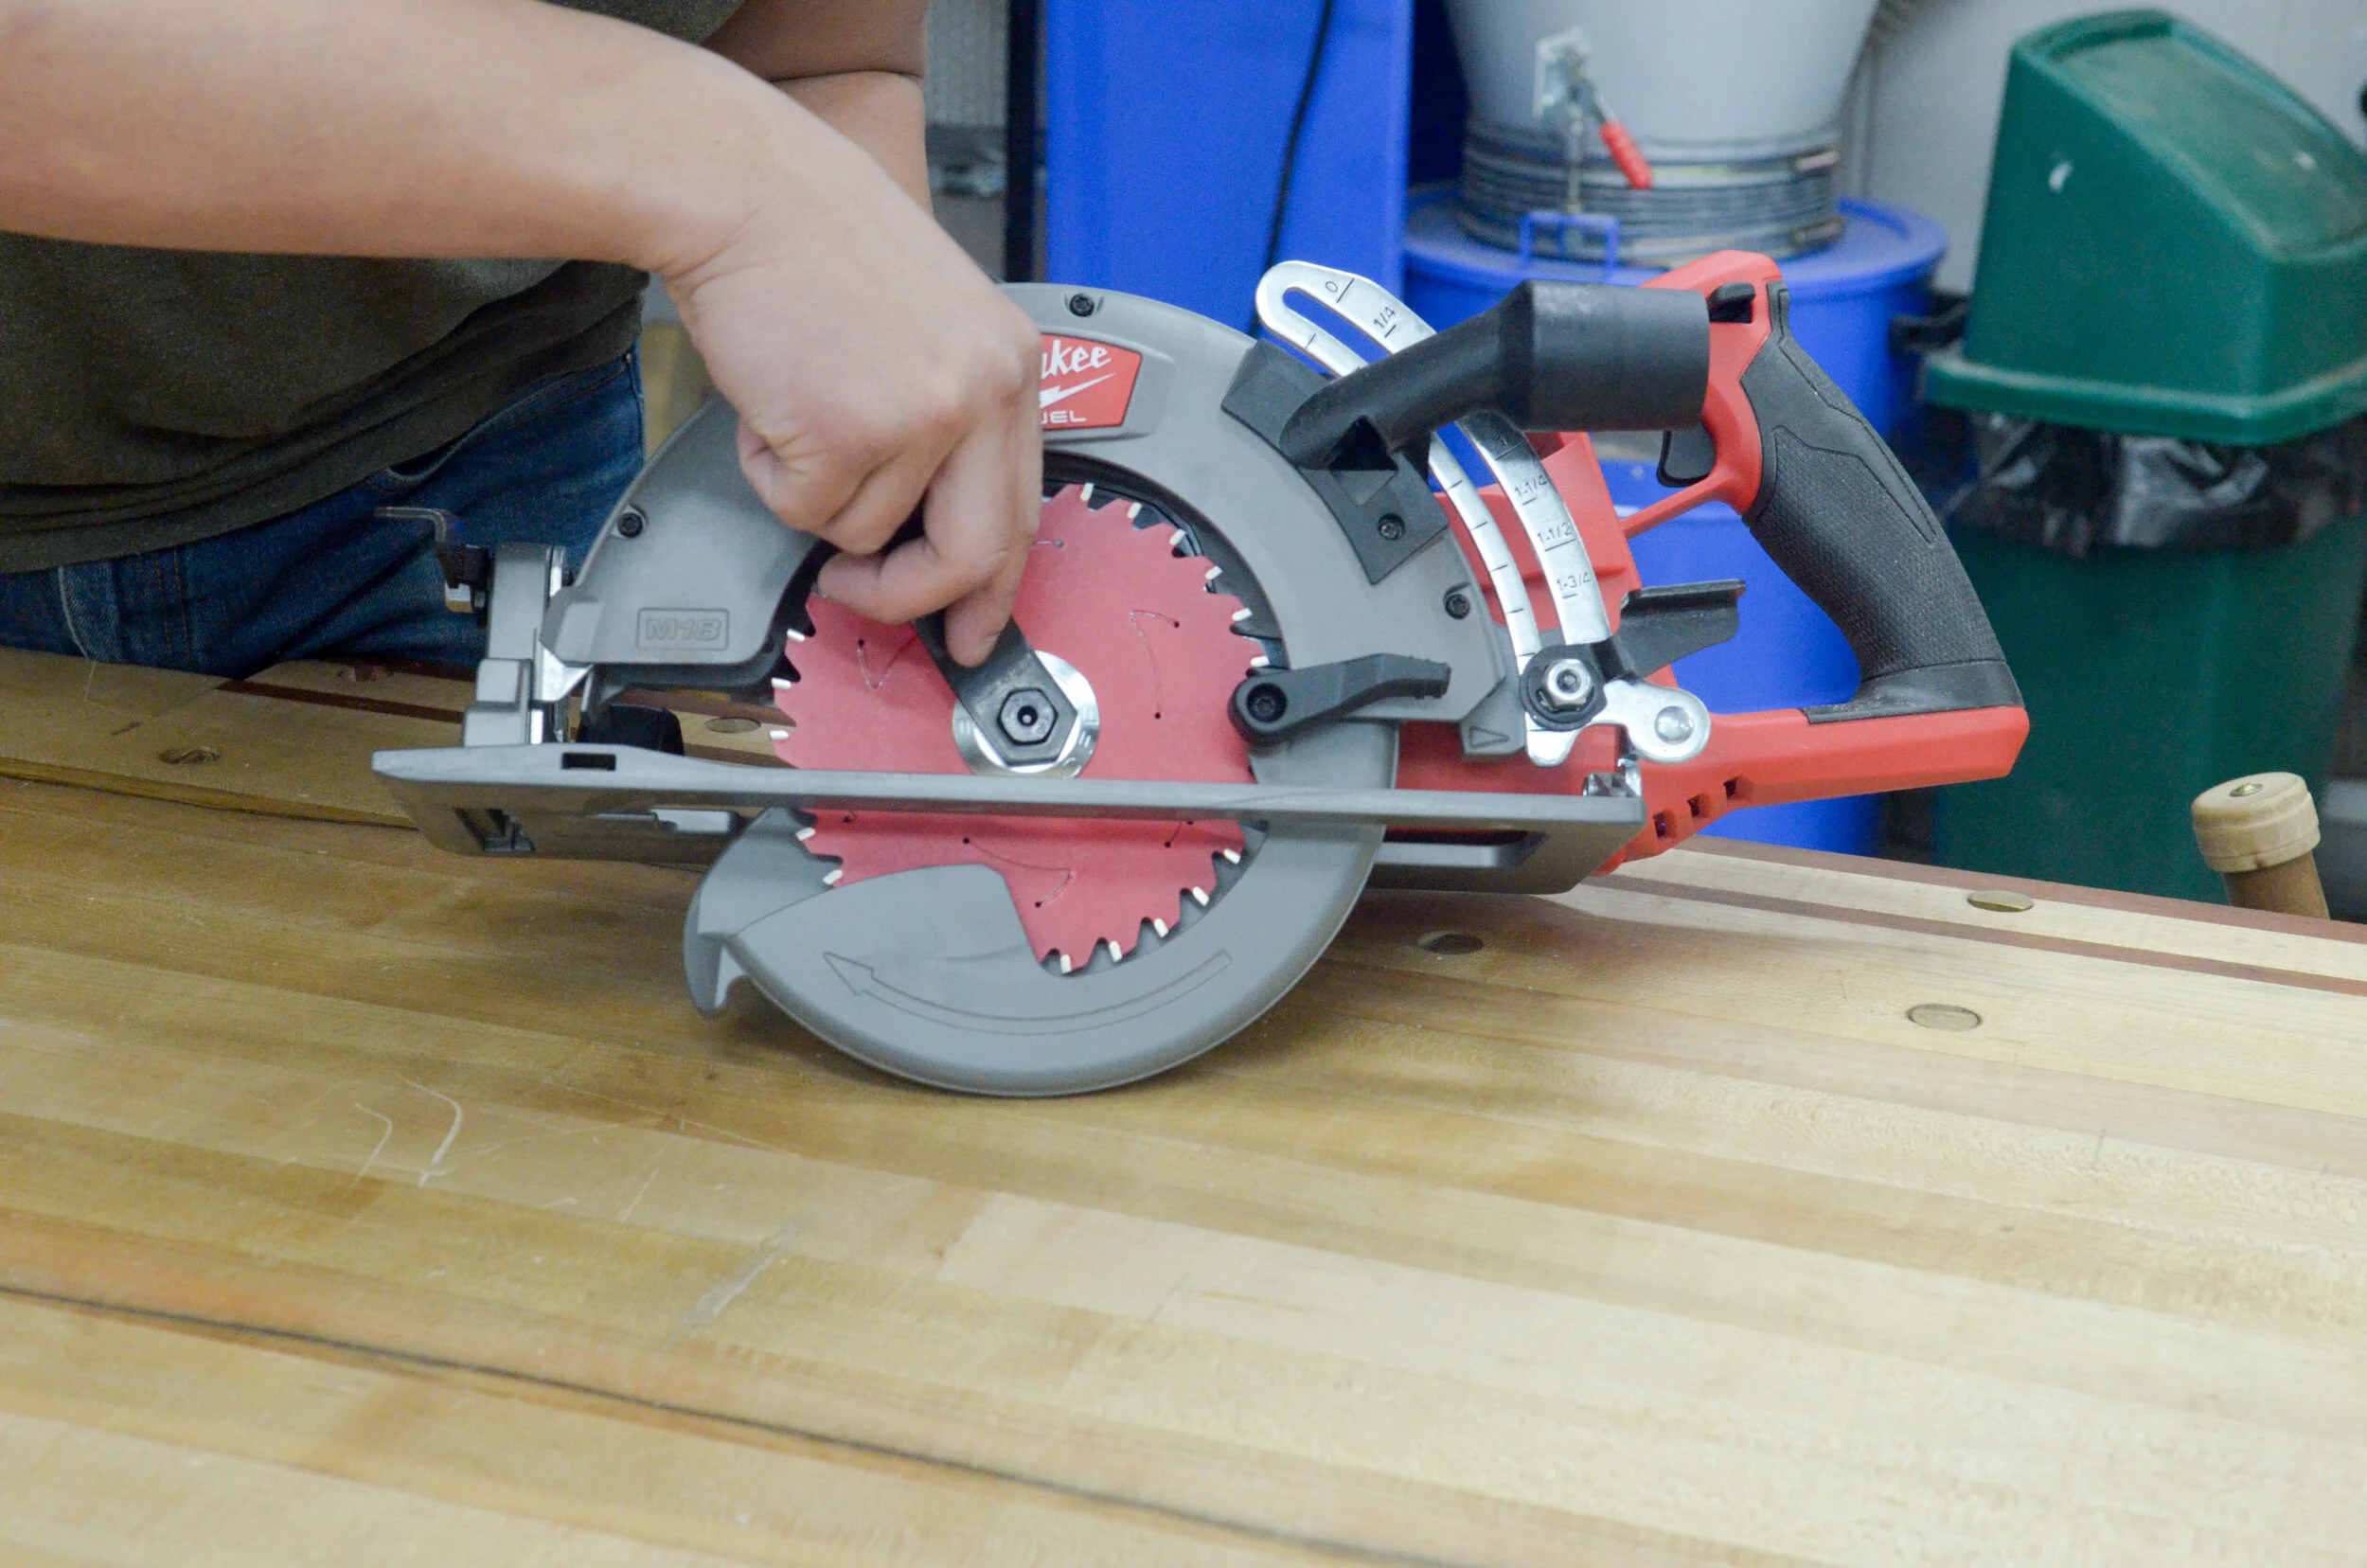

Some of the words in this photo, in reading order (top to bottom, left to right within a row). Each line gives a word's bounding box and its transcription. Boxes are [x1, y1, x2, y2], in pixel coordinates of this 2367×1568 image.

[1326, 280, 1339, 294] 0
[1373, 306, 1397, 330] 1/4
[1515, 474, 1548, 498] 1-1/4
[1538, 522, 1574, 544] 1-1/2
[1557, 571, 1592, 592] 1-3/4
[645, 617, 721, 642] M18
